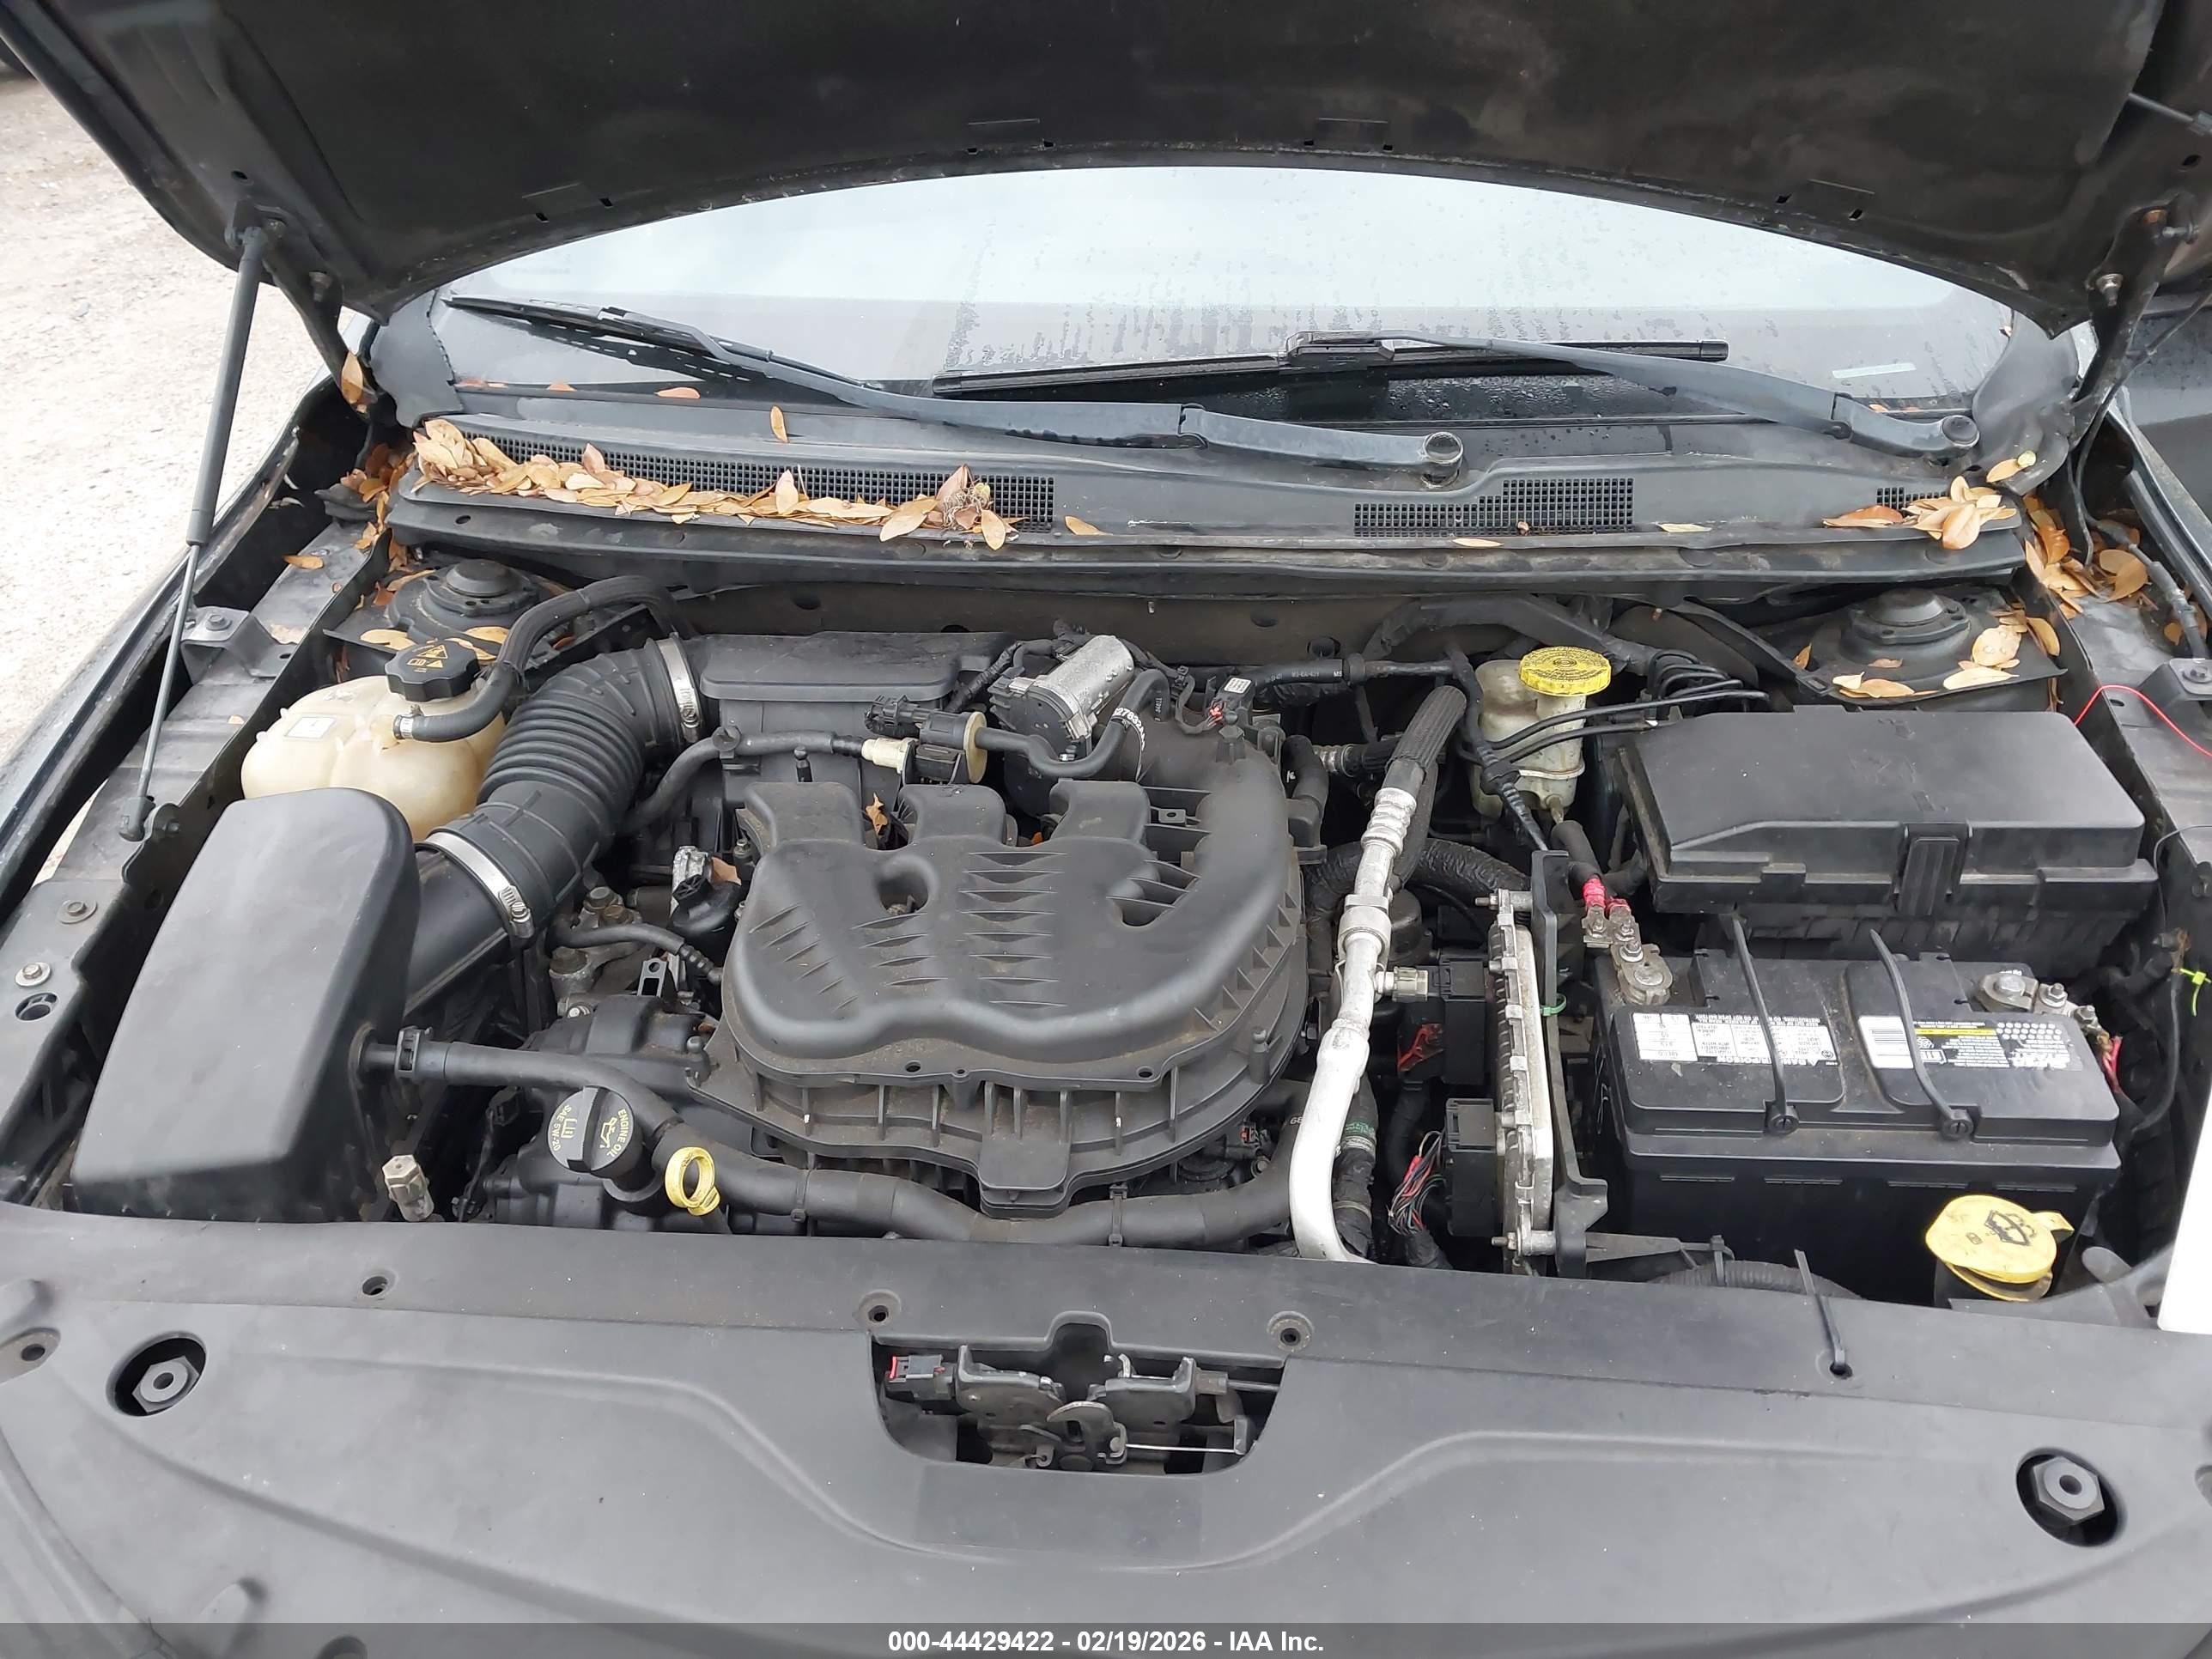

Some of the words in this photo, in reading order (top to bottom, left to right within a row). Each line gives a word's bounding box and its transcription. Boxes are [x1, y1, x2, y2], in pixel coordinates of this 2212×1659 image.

[556, 1104, 572, 1122] SAE
[551, 1122, 562, 1152] 5W-20
[617, 1109, 629, 1143] ENGINE
[606, 1144, 622, 1158] OIL
